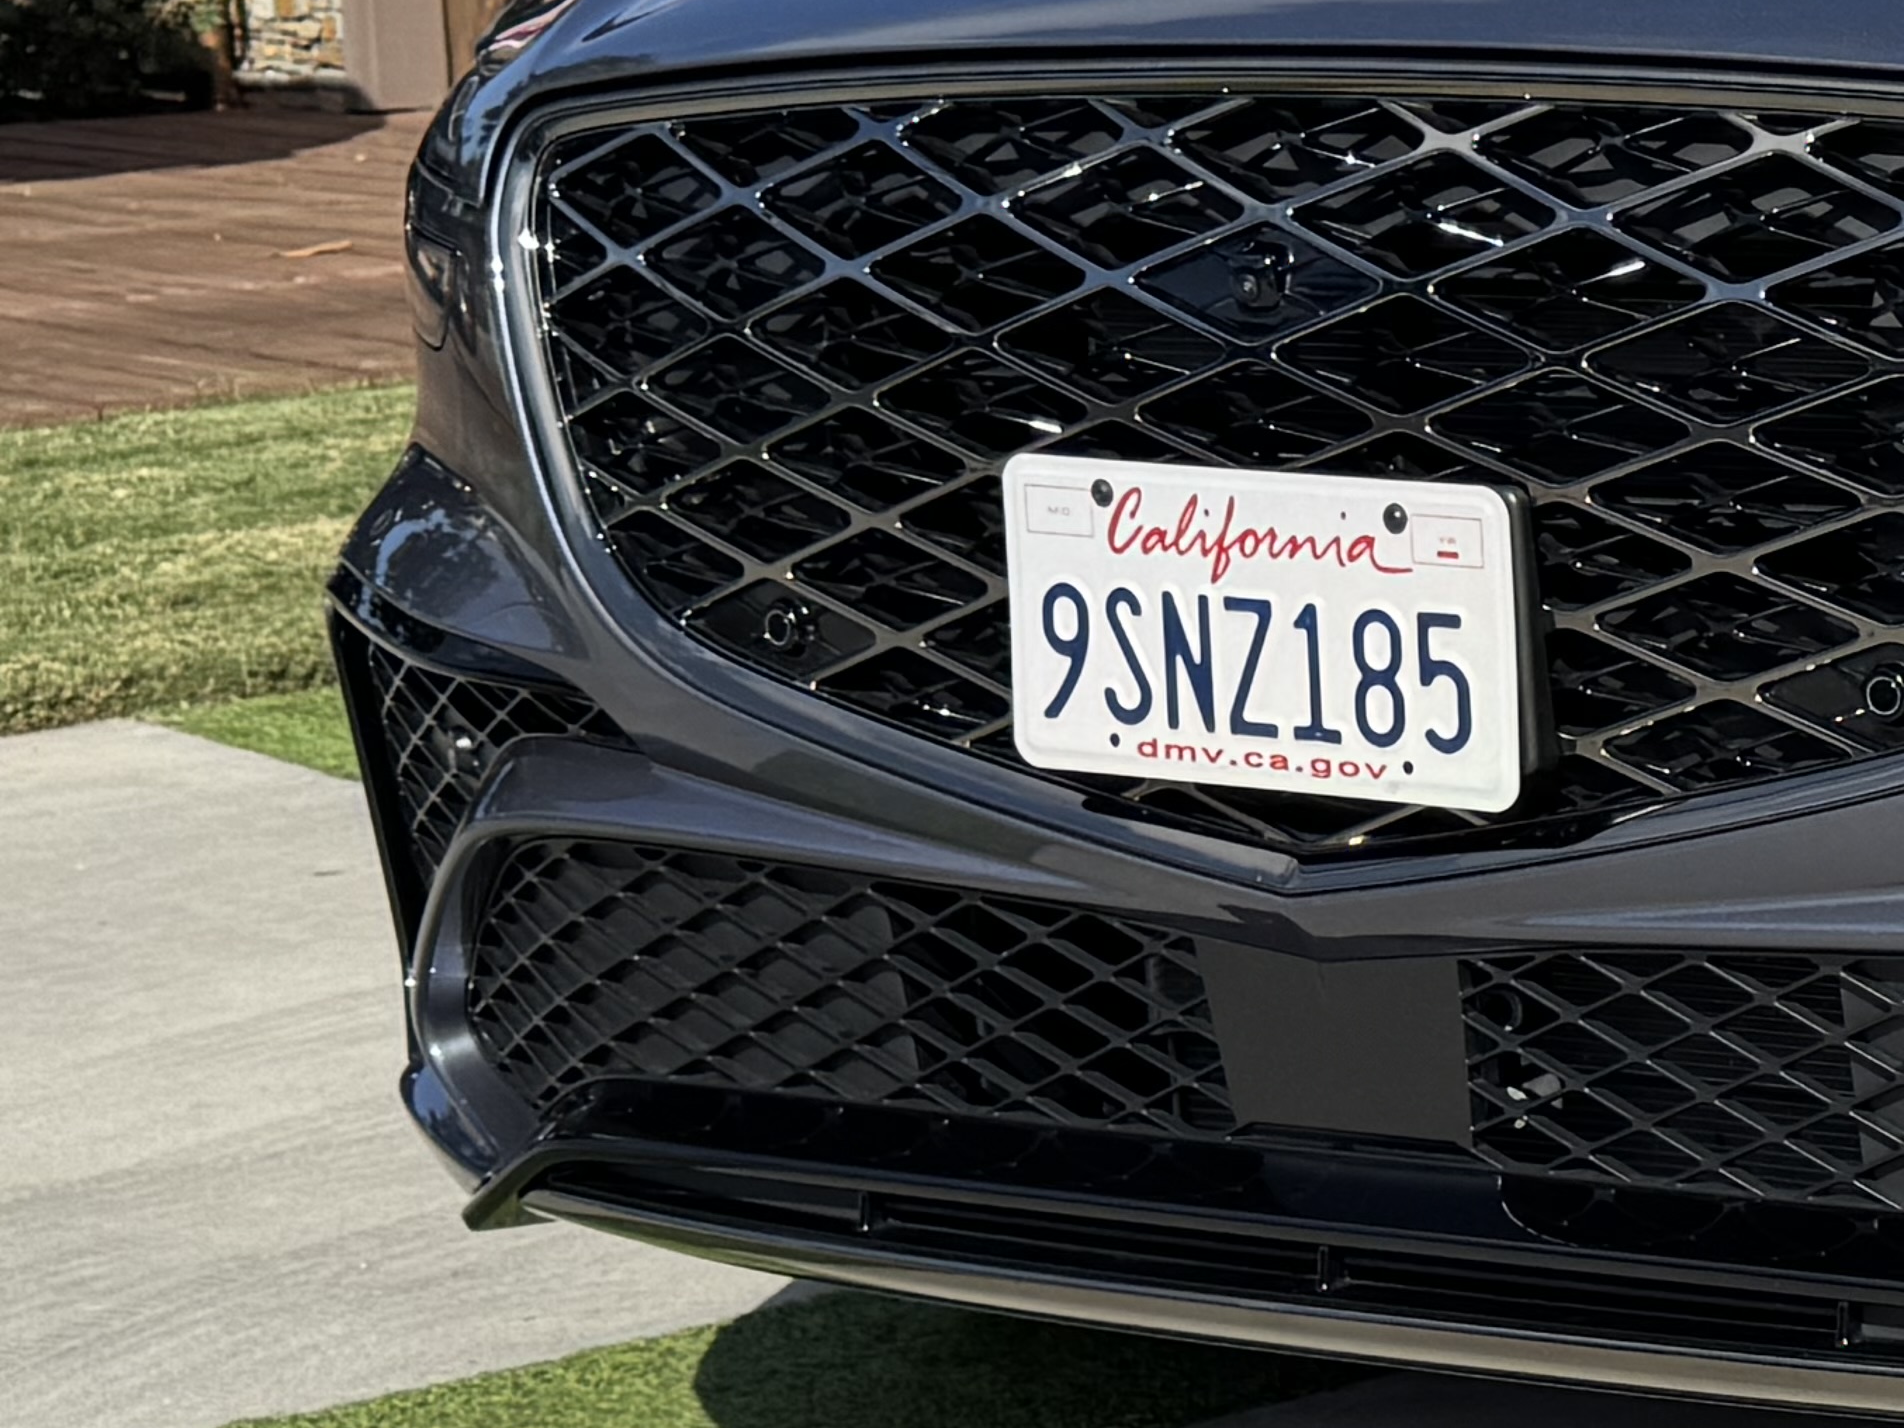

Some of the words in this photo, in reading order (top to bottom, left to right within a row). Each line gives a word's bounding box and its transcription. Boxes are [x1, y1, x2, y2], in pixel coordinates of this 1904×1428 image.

[1107, 486, 1413, 583] California
[1043, 583, 1471, 754] 9SNZ185
[1136, 737, 1388, 780] dmv.ca.gov
